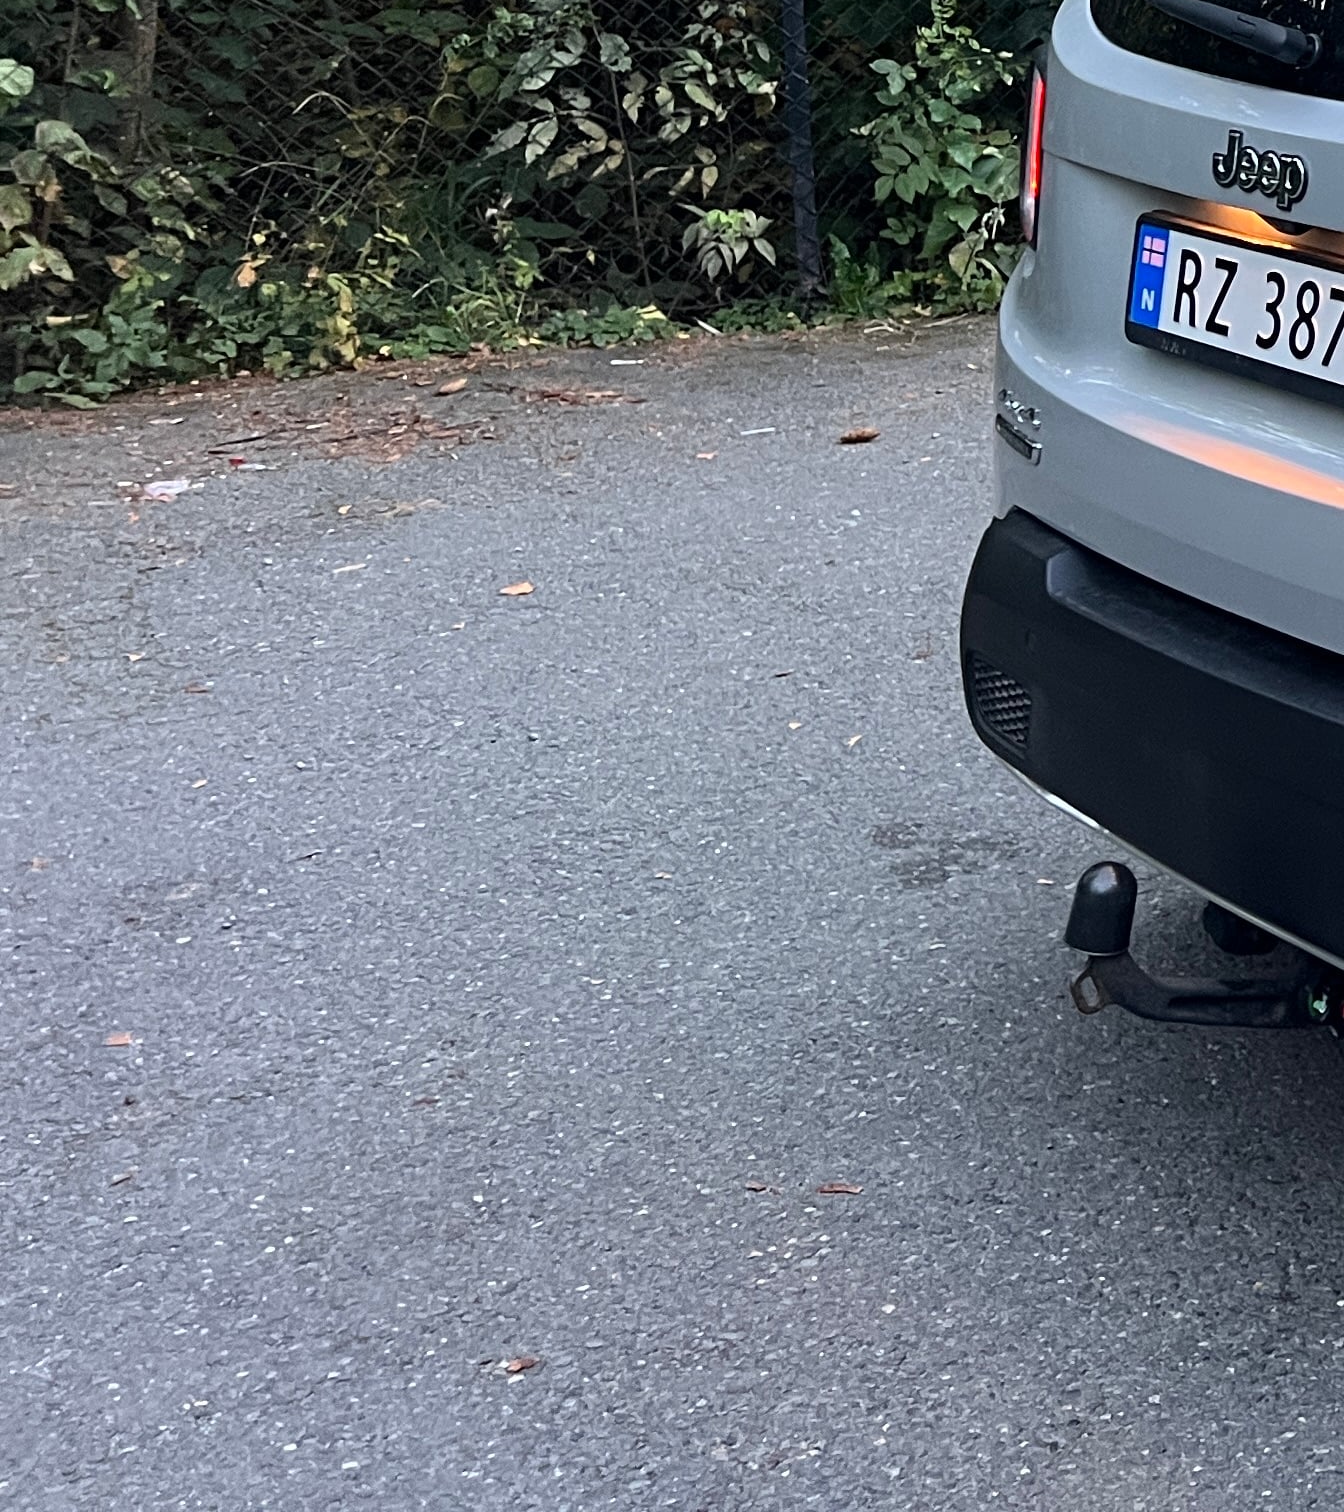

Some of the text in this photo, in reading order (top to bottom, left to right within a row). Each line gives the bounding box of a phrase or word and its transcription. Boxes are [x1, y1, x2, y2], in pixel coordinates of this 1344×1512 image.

[1212, 128, 1309, 212] Jeep
[1140, 289, 1155, 312] N
[1173, 248, 1239, 337] RZ
